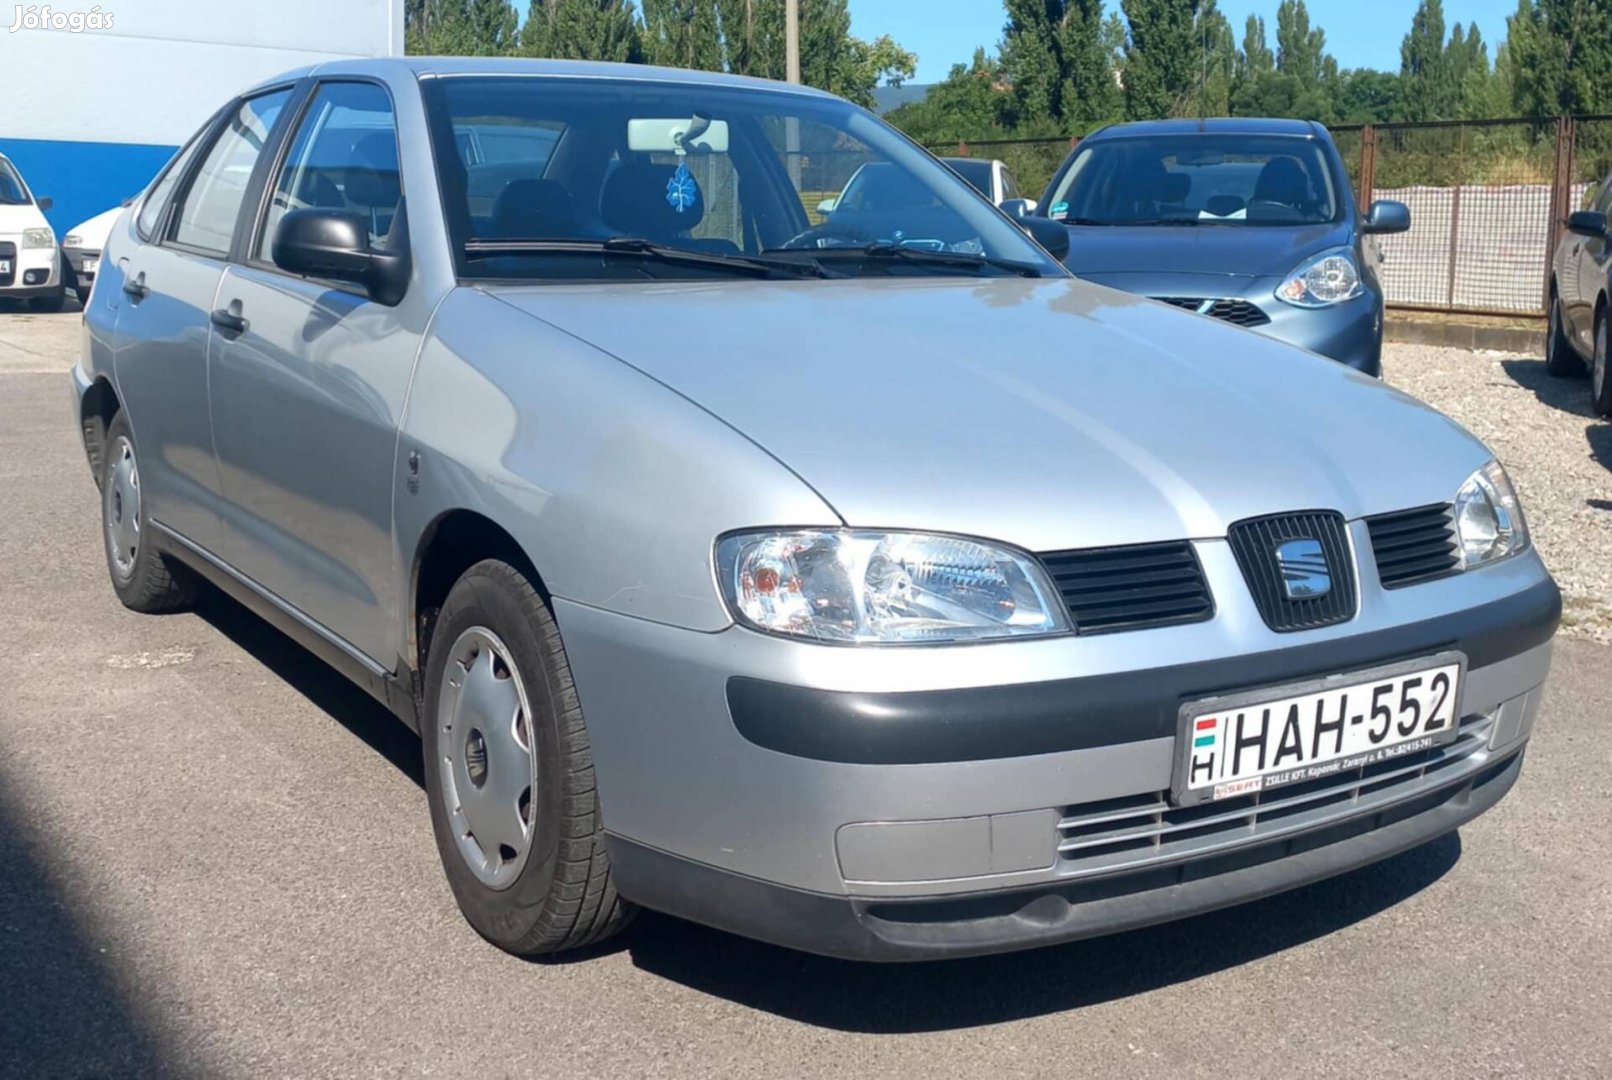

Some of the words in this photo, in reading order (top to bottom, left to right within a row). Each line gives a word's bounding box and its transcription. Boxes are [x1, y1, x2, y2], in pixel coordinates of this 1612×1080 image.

[1231, 672, 1451, 777] HAH-552
[1190, 752, 1215, 784] H
[1227, 780, 1260, 793] SEAT
